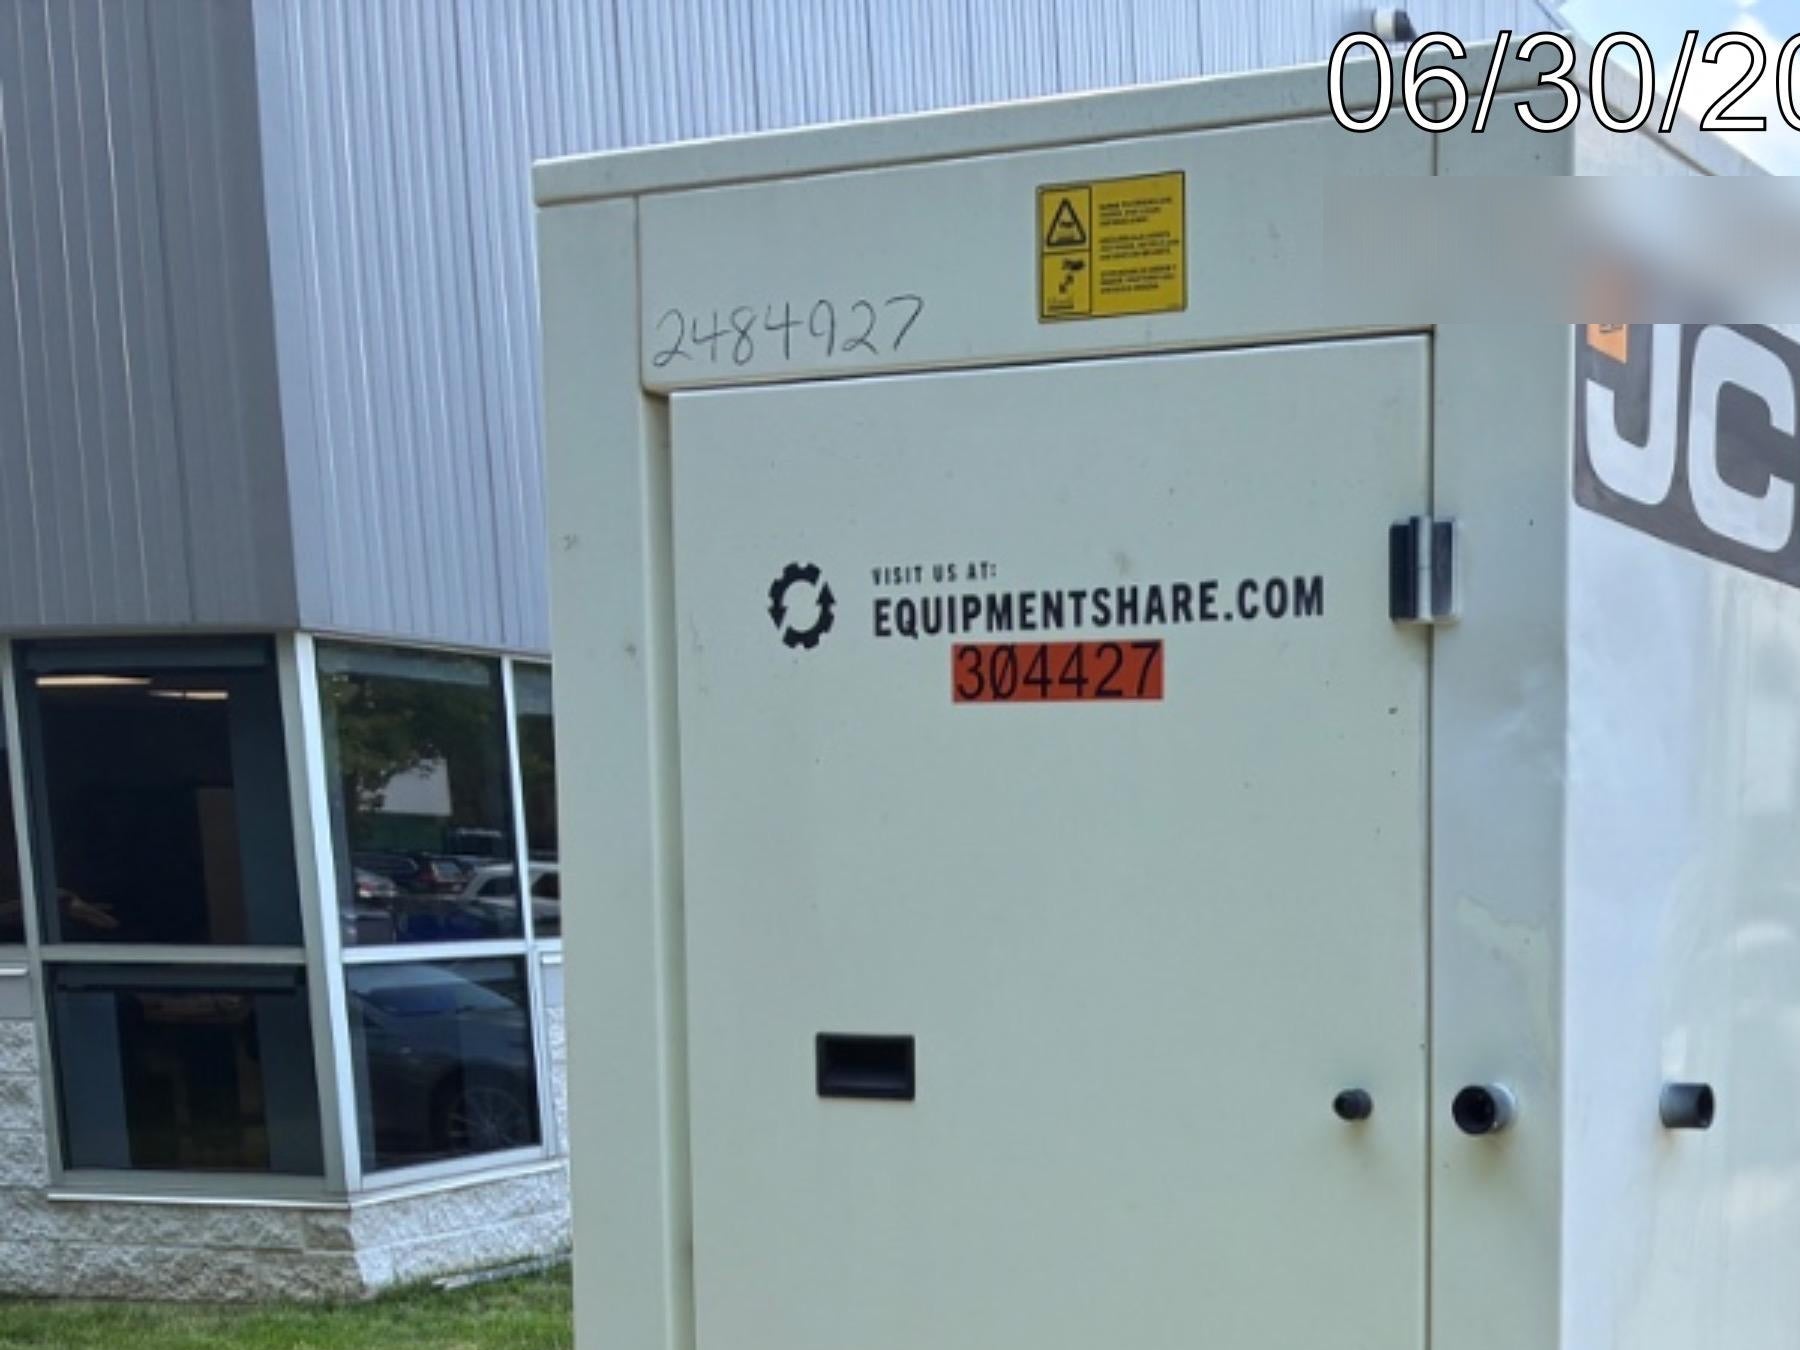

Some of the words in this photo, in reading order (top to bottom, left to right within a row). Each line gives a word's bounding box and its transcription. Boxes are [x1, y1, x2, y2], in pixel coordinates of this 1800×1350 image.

[652, 293, 925, 368] 2484927
[872, 565, 923, 586] VISIT
[932, 562, 958, 582] US
[965, 560, 997, 580] AT:
[873, 575, 1325, 640] EQUIPMENTSHARE.COM
[955, 640, 1162, 700] 304427
